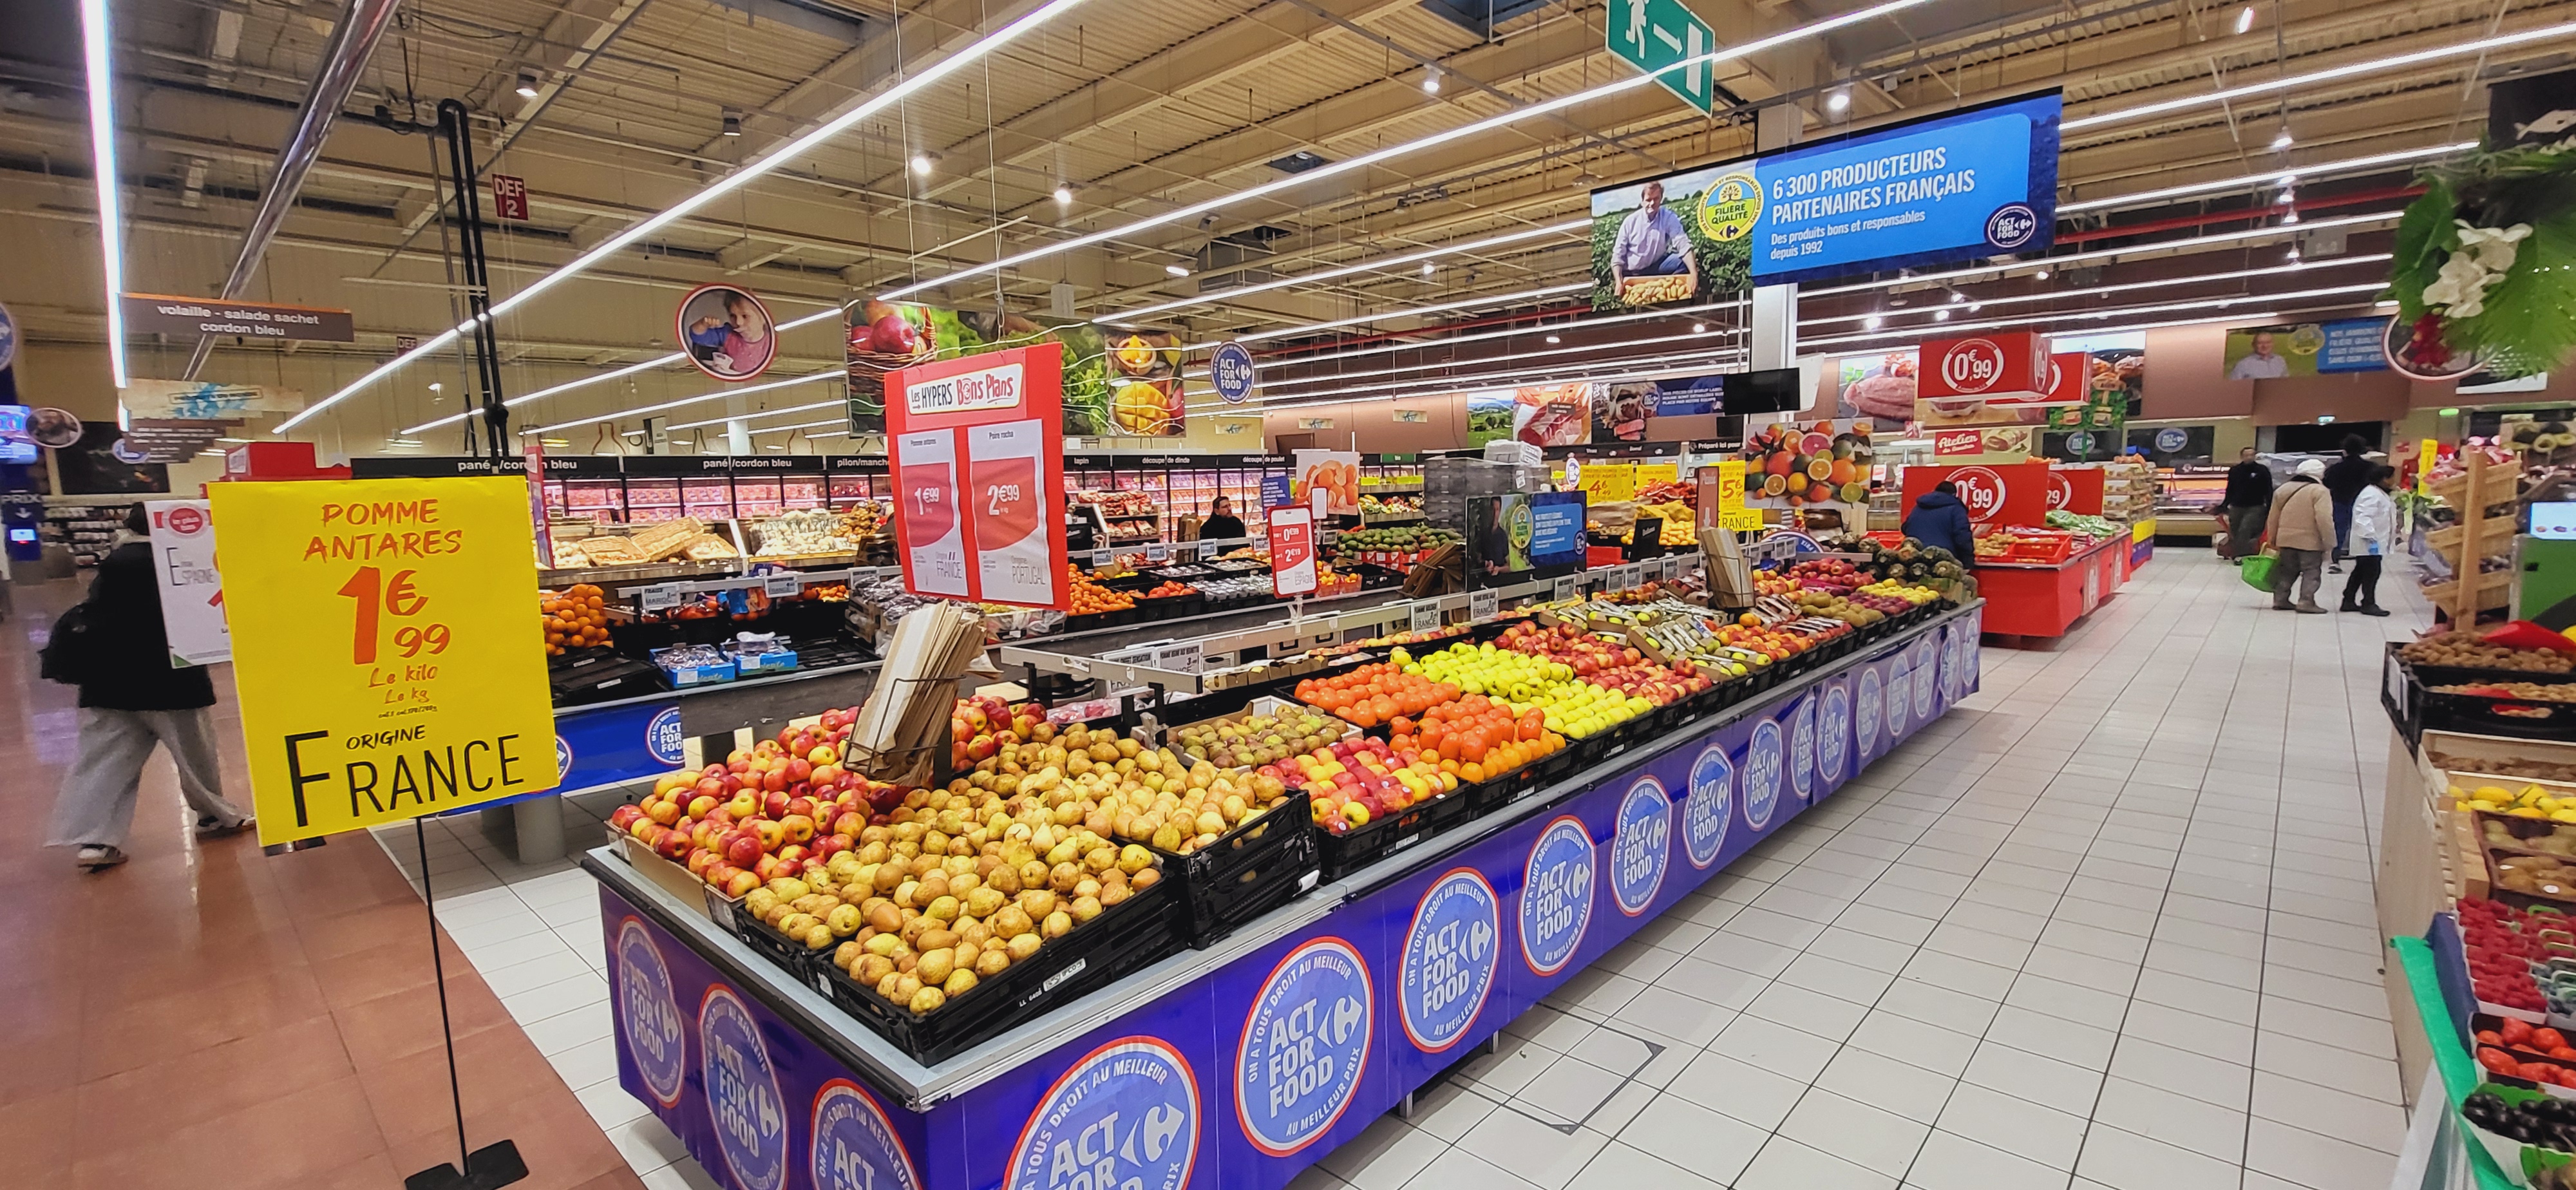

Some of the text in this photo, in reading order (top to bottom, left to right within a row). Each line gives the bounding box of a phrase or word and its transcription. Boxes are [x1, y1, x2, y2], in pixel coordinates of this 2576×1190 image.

[495, 177, 522, 198] DEF
[1772, 147, 1946, 200] 6 300 PRODUCTEURS
[507, 199, 520, 216] 2
[1772, 169, 1975, 225] PARTENAIRES FRANÇAIS
[1771, 210, 1926, 245] Des produits bons et responsables
[1996, 230, 2020, 240] FOOD
[1997, 225, 2013, 234] FOR
[1998, 217, 2016, 227] ACT
[1770, 240, 1823, 261] depuis 1992
[157, 305, 319, 325] volaille salade sachet
[200, 323, 285, 335] cordon bleu
[397, 337, 417, 349] DEF
[1220, 358, 1235, 370] ACT
[1220, 369, 1236, 380] FOR
[911, 389, 920, 402] Les
[922, 382, 952, 408] HYPERS
[985, 373, 1013, 399] Plans
[1220, 379, 1242, 390] FOOD
[1698, 442, 1718, 450] Préparé
[457, 460, 490, 472] pané
[551, 460, 577, 469] bleu
[703, 458, 792, 469] pané /cordon bleu
[1142, 457, 1166, 465] découpe
[1, 494, 41, 504] PRIX
[321, 499, 439, 527] POMME
[987, 484, 1020, 516] 2€99
[1718, 516, 1756, 529] RANCE
[303, 529, 462, 563] ANTARES
[1012, 565, 1046, 585] PORTUGAL
[368, 664, 438, 688] Le kilo
[384, 687, 430, 704] Le kg
[346, 724, 426, 750] ORIGINE
[660, 722, 681, 735] ACT
[661, 733, 682, 744] FOR
[661, 741, 683, 753] FOO
[284, 730, 524, 827] FRANCE
[1695, 779, 1716, 807] ACT
[1693, 800, 1710, 826] FOR
[1625, 815, 1650, 847] ACT
[1693, 815, 1718, 844] FOOD
[1530, 862, 1540, 889] TOUS
[1537, 836, 1553, 863] DROIT
[1553, 830, 1562, 843] AU
[1562, 829, 1585, 851] MEILLEUR
[1624, 838, 1645, 868] FOR
[1537, 860, 1567, 899] ACT
[1624, 854, 1653, 889] FOOD
[1537, 888, 1563, 922] FOR
[1408, 968, 1416, 987] ON
[1412, 923, 1428, 954] TOUS
[1425, 891, 1444, 924] DROIT
[1444, 885, 1454, 900] AU
[1455, 883, 1486, 907] MEILLEUR
[1537, 904, 1573, 946] FOOD
[1545, 902, 1588, 962] AU MEILLEUR PRIX
[1423, 919, 1460, 966] ACT
[1423, 951, 1457, 992] FOR
[1423, 968, 1470, 1019] FOOD
[1434, 964, 1490, 1037] AU MEILLEUR PRIX
[1249, 955, 1352, 1083] ON A TOUS DROIT AU MEILLEUR
[1269, 997, 1317, 1056] ACT
[715, 1034, 746, 1084] ACT
[1269, 1035, 1316, 1088] FOR
[718, 1064, 748, 1118] FOR
[1270, 1055, 1334, 1119] FOOD
[1285, 1046, 1360, 1137] AU MEILLEUR PRIX
[719, 1096, 760, 1158] FOOD
[856, 1107, 867, 1126] AU
[1026, 1058, 1169, 1176] TOUS DROIT AU MEILLEUR
[820, 1142, 828, 1155] A
[1048, 1111, 1119, 1189] ACT
[819, 1153, 827, 1178] ON
[834, 1137, 875, 1190] ACT
